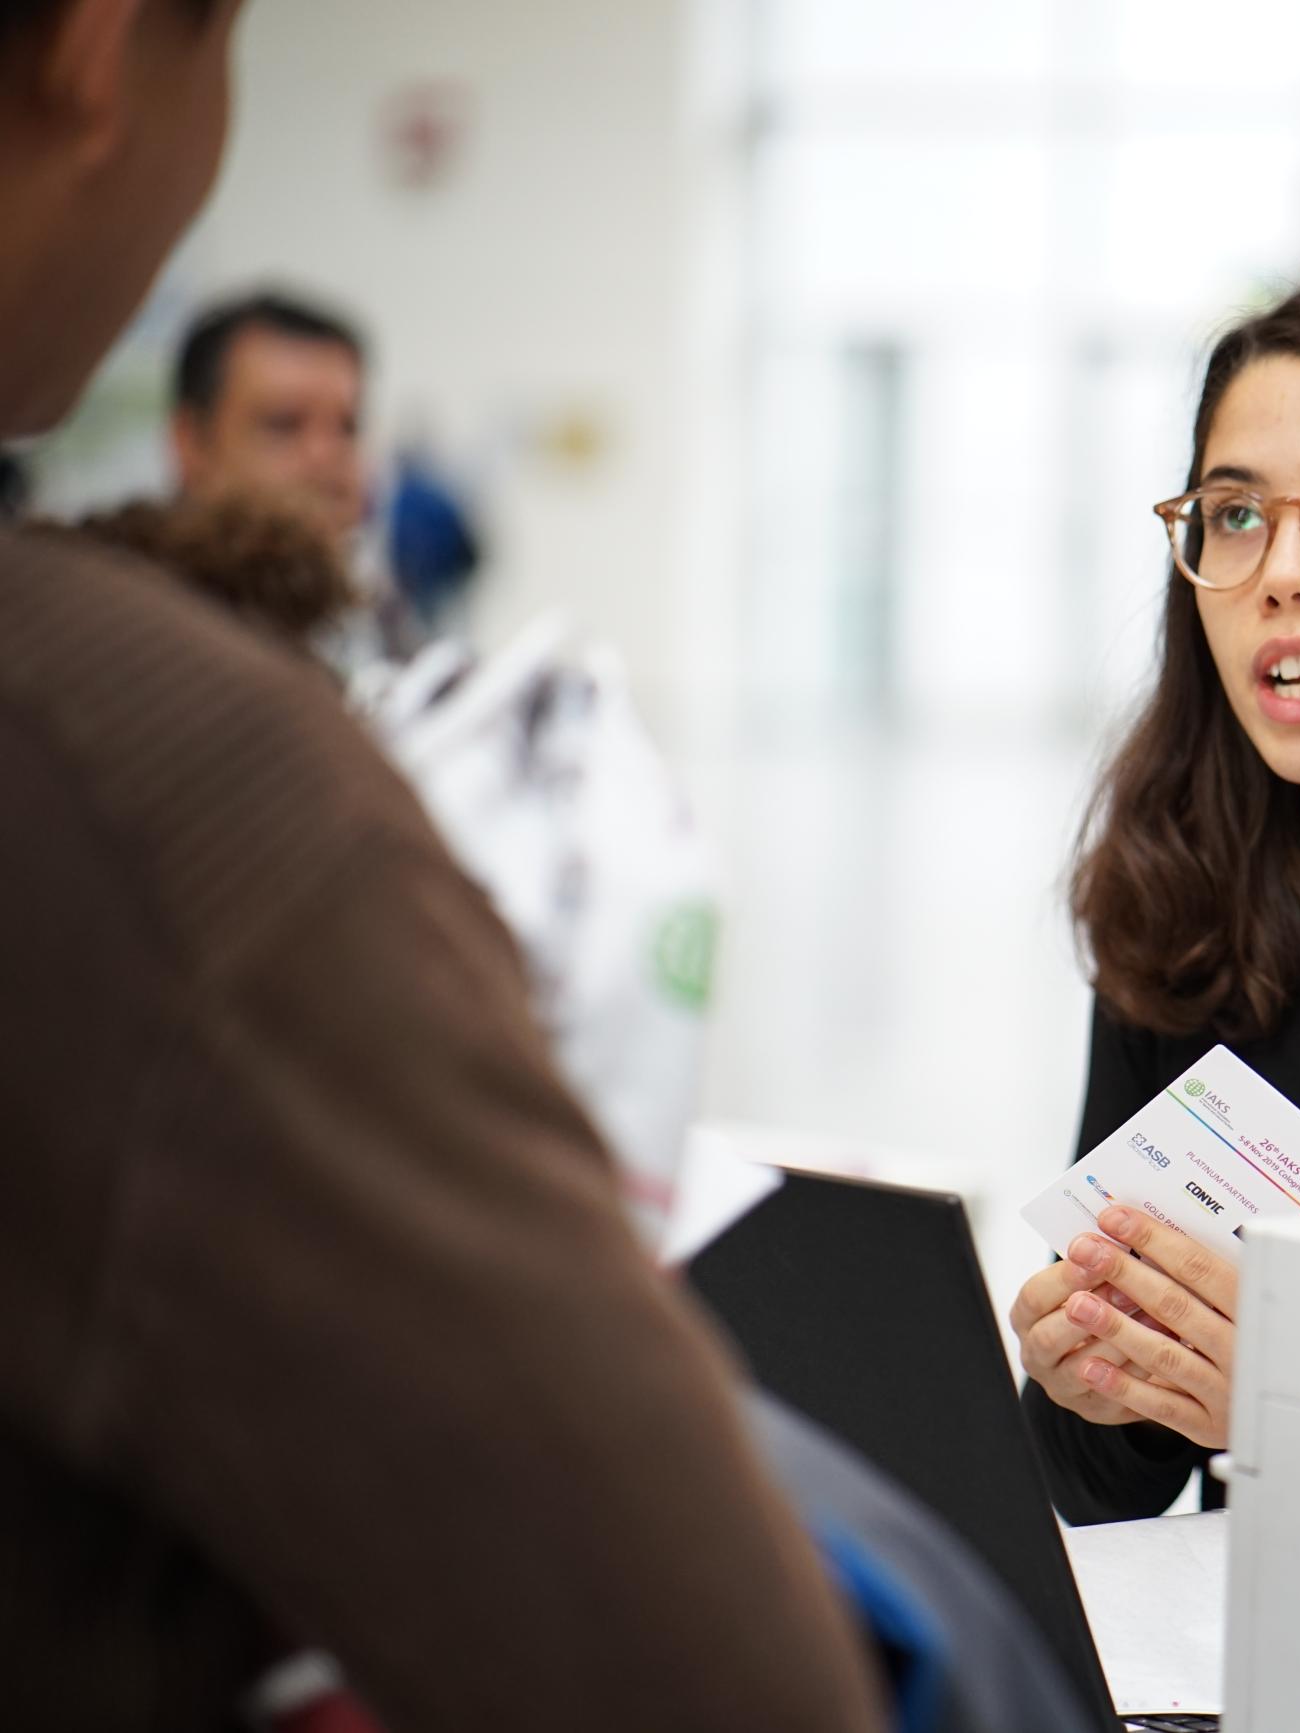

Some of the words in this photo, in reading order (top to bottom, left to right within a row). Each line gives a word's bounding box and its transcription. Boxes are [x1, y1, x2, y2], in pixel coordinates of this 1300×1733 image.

[1204, 1090, 1231, 1114] IAKS
[1142, 1145, 1171, 1168] ASB
[1262, 1156, 1280, 1171] 2019
[1185, 1151, 1224, 1184] PLATINUM
[1222, 1182, 1259, 1215] PARTNERS
[1185, 1181, 1225, 1215] CONVIC
[1143, 1201, 1165, 1221] GOLD
